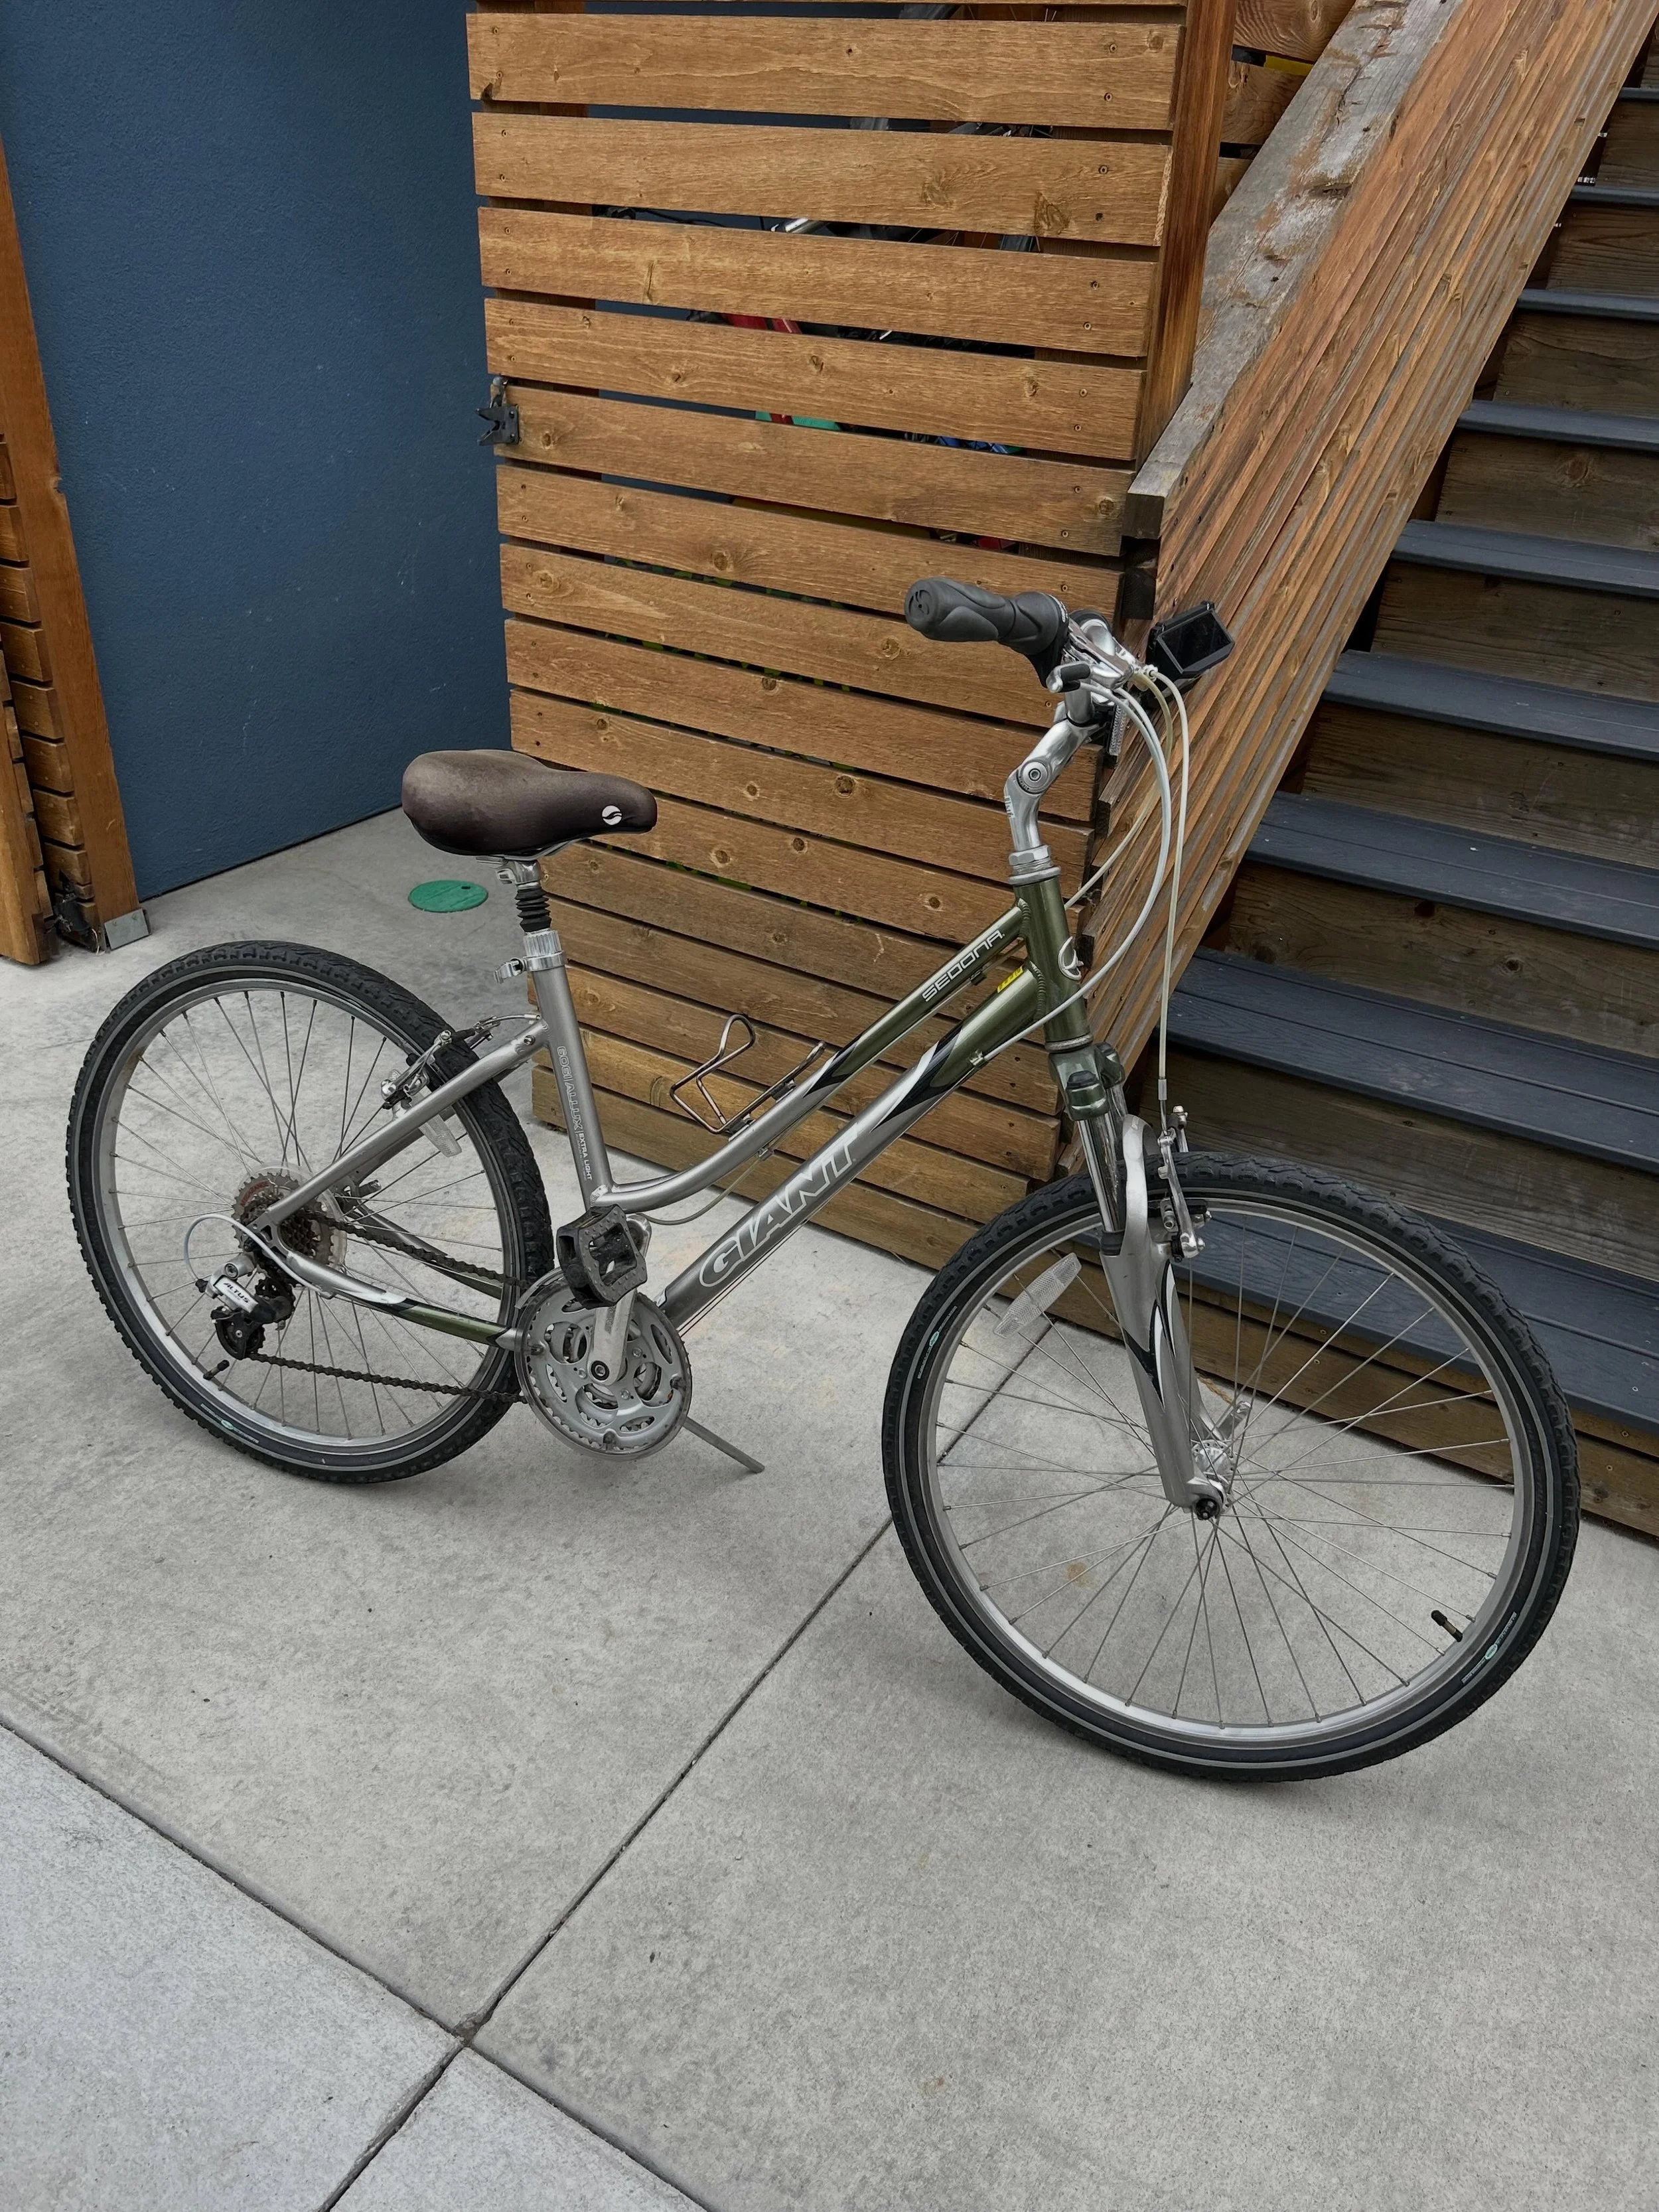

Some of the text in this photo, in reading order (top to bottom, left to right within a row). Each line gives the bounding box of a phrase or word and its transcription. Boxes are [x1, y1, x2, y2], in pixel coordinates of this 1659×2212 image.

[922, 930, 1003, 1002] SEDONA
[579, 1132, 588, 1158] EXTRA
[584, 1159, 593, 1180] LIGHT
[699, 1122, 858, 1287] GIANT
[223, 1283, 250, 1303] ALTUS
